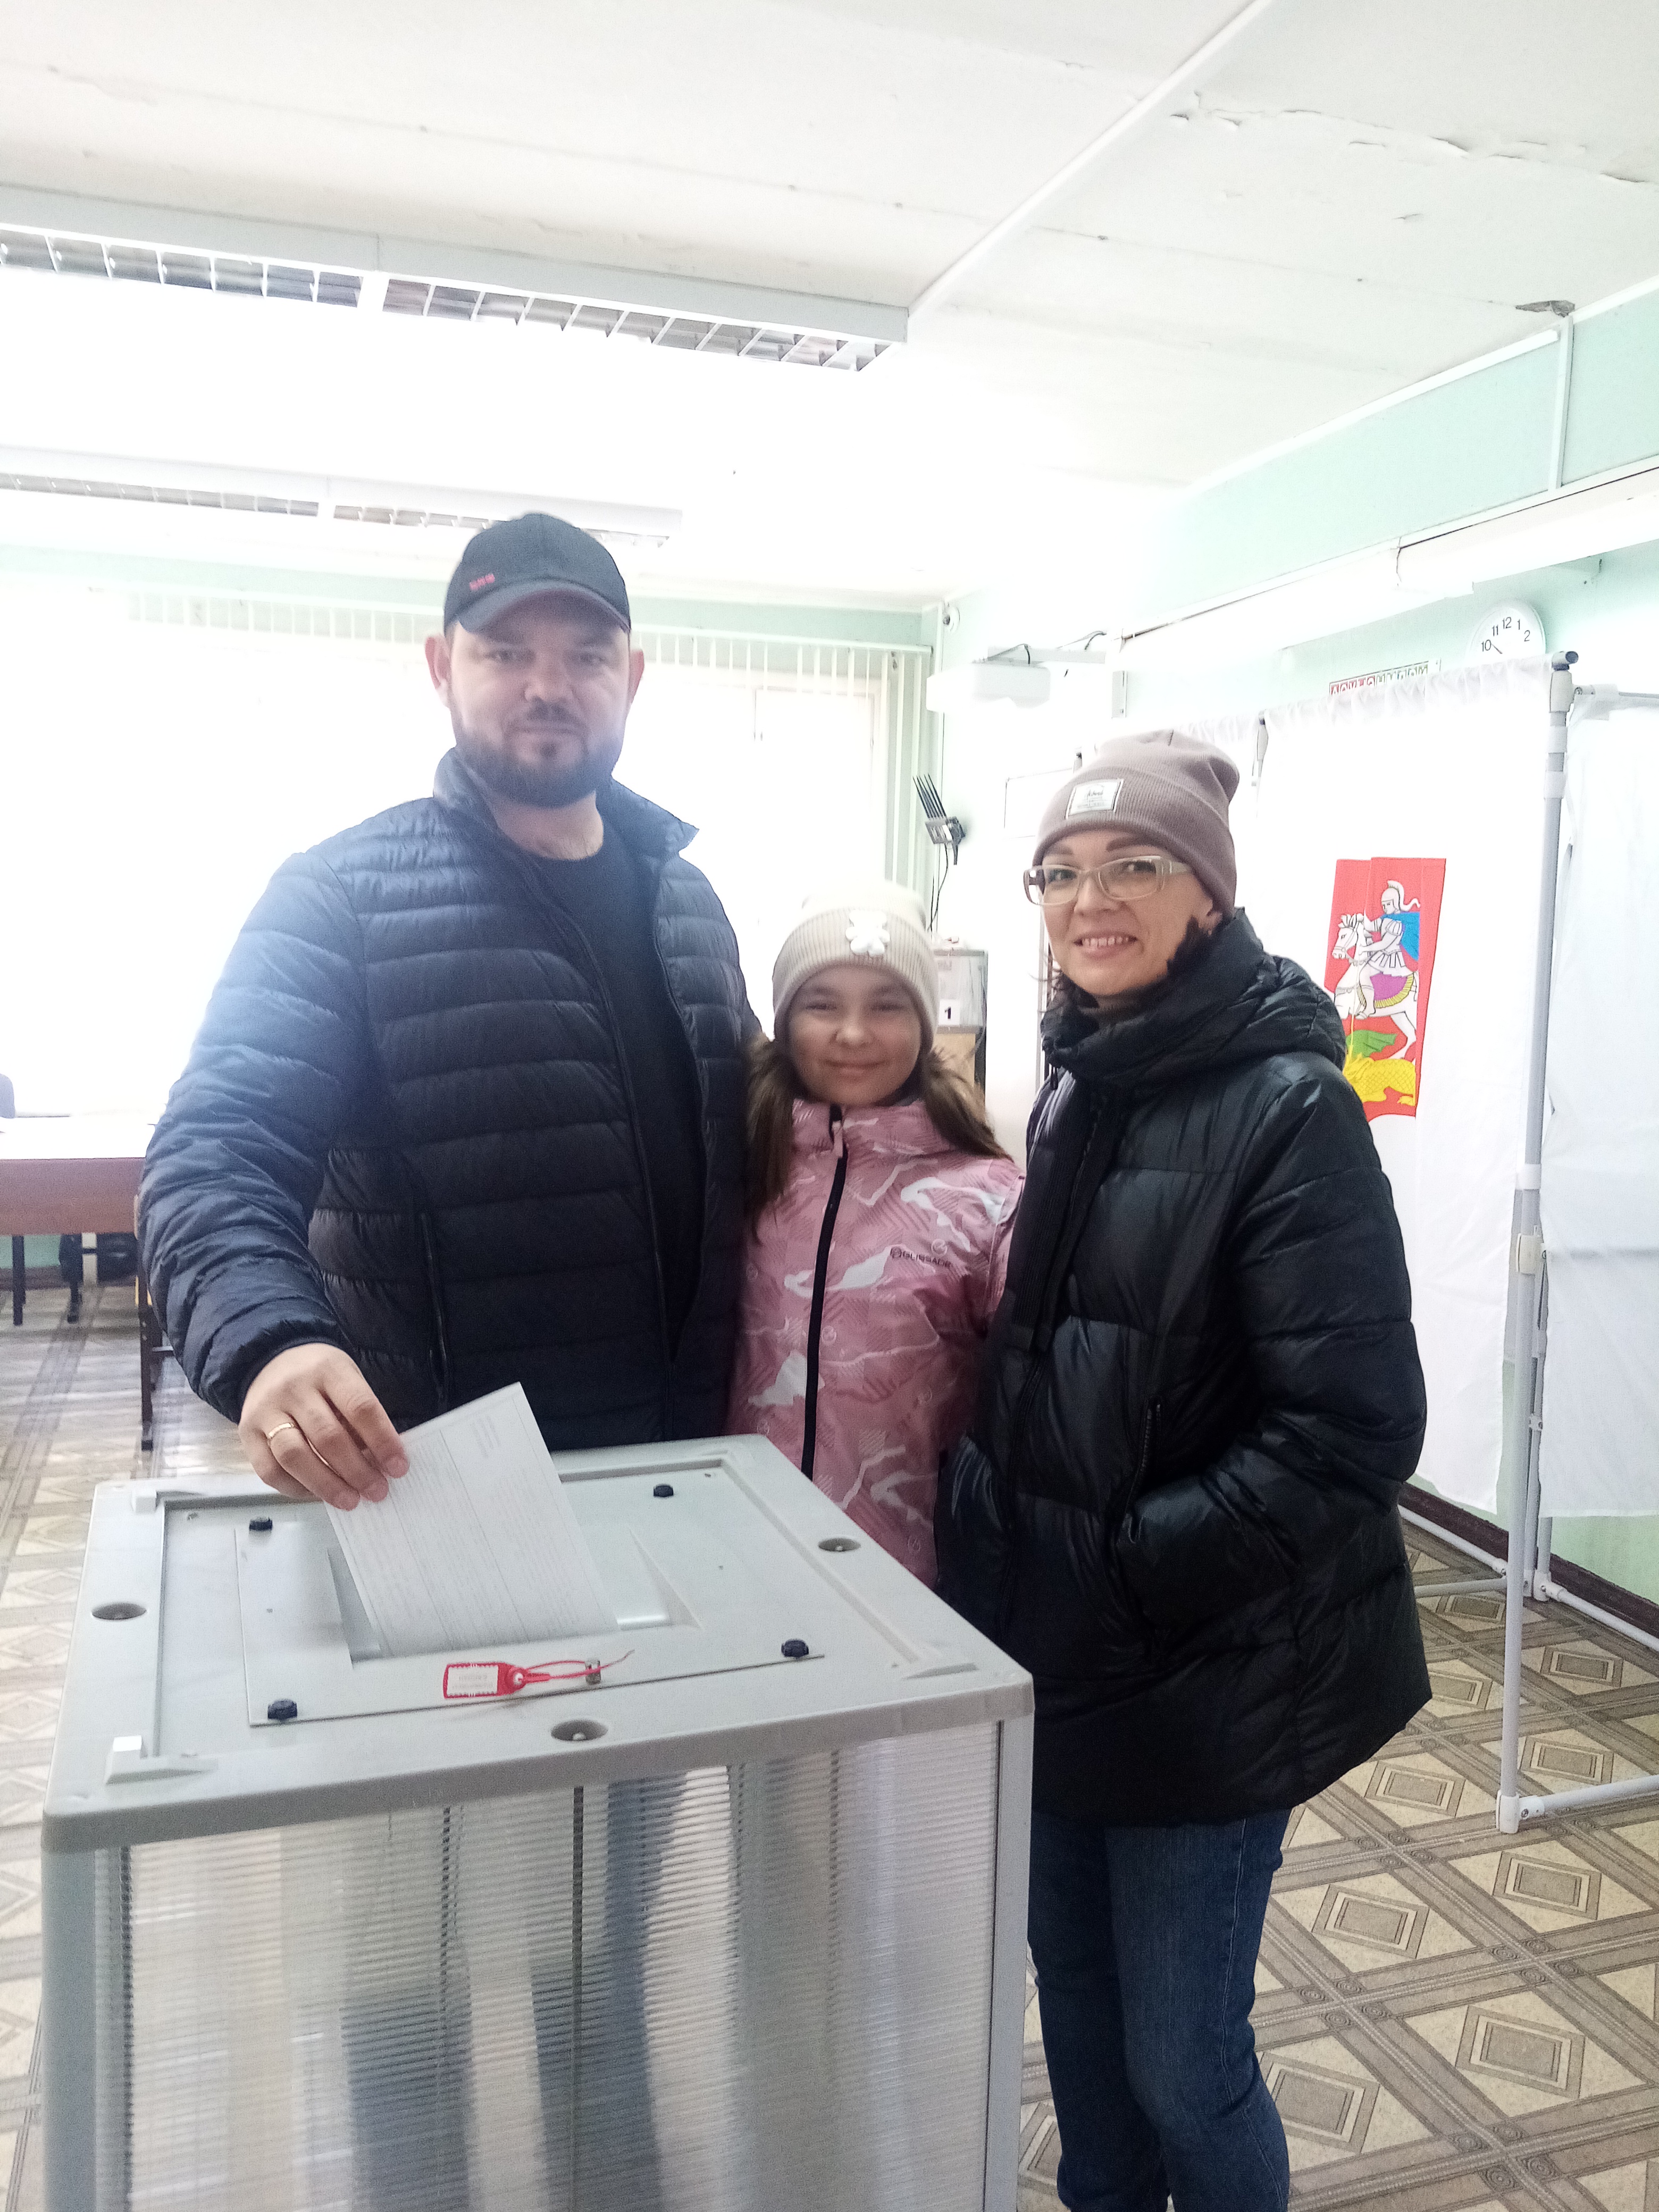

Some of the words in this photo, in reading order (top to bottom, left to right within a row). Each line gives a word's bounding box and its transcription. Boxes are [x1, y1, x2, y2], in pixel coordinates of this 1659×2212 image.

[1502, 616, 1512, 630] 12
[1516, 618, 1521, 631] 1
[1492, 624, 1498, 636] 11
[1523, 630, 1531, 642] 2
[1481, 639, 1492, 652] 10
[944, 1007, 951, 1020] 1
